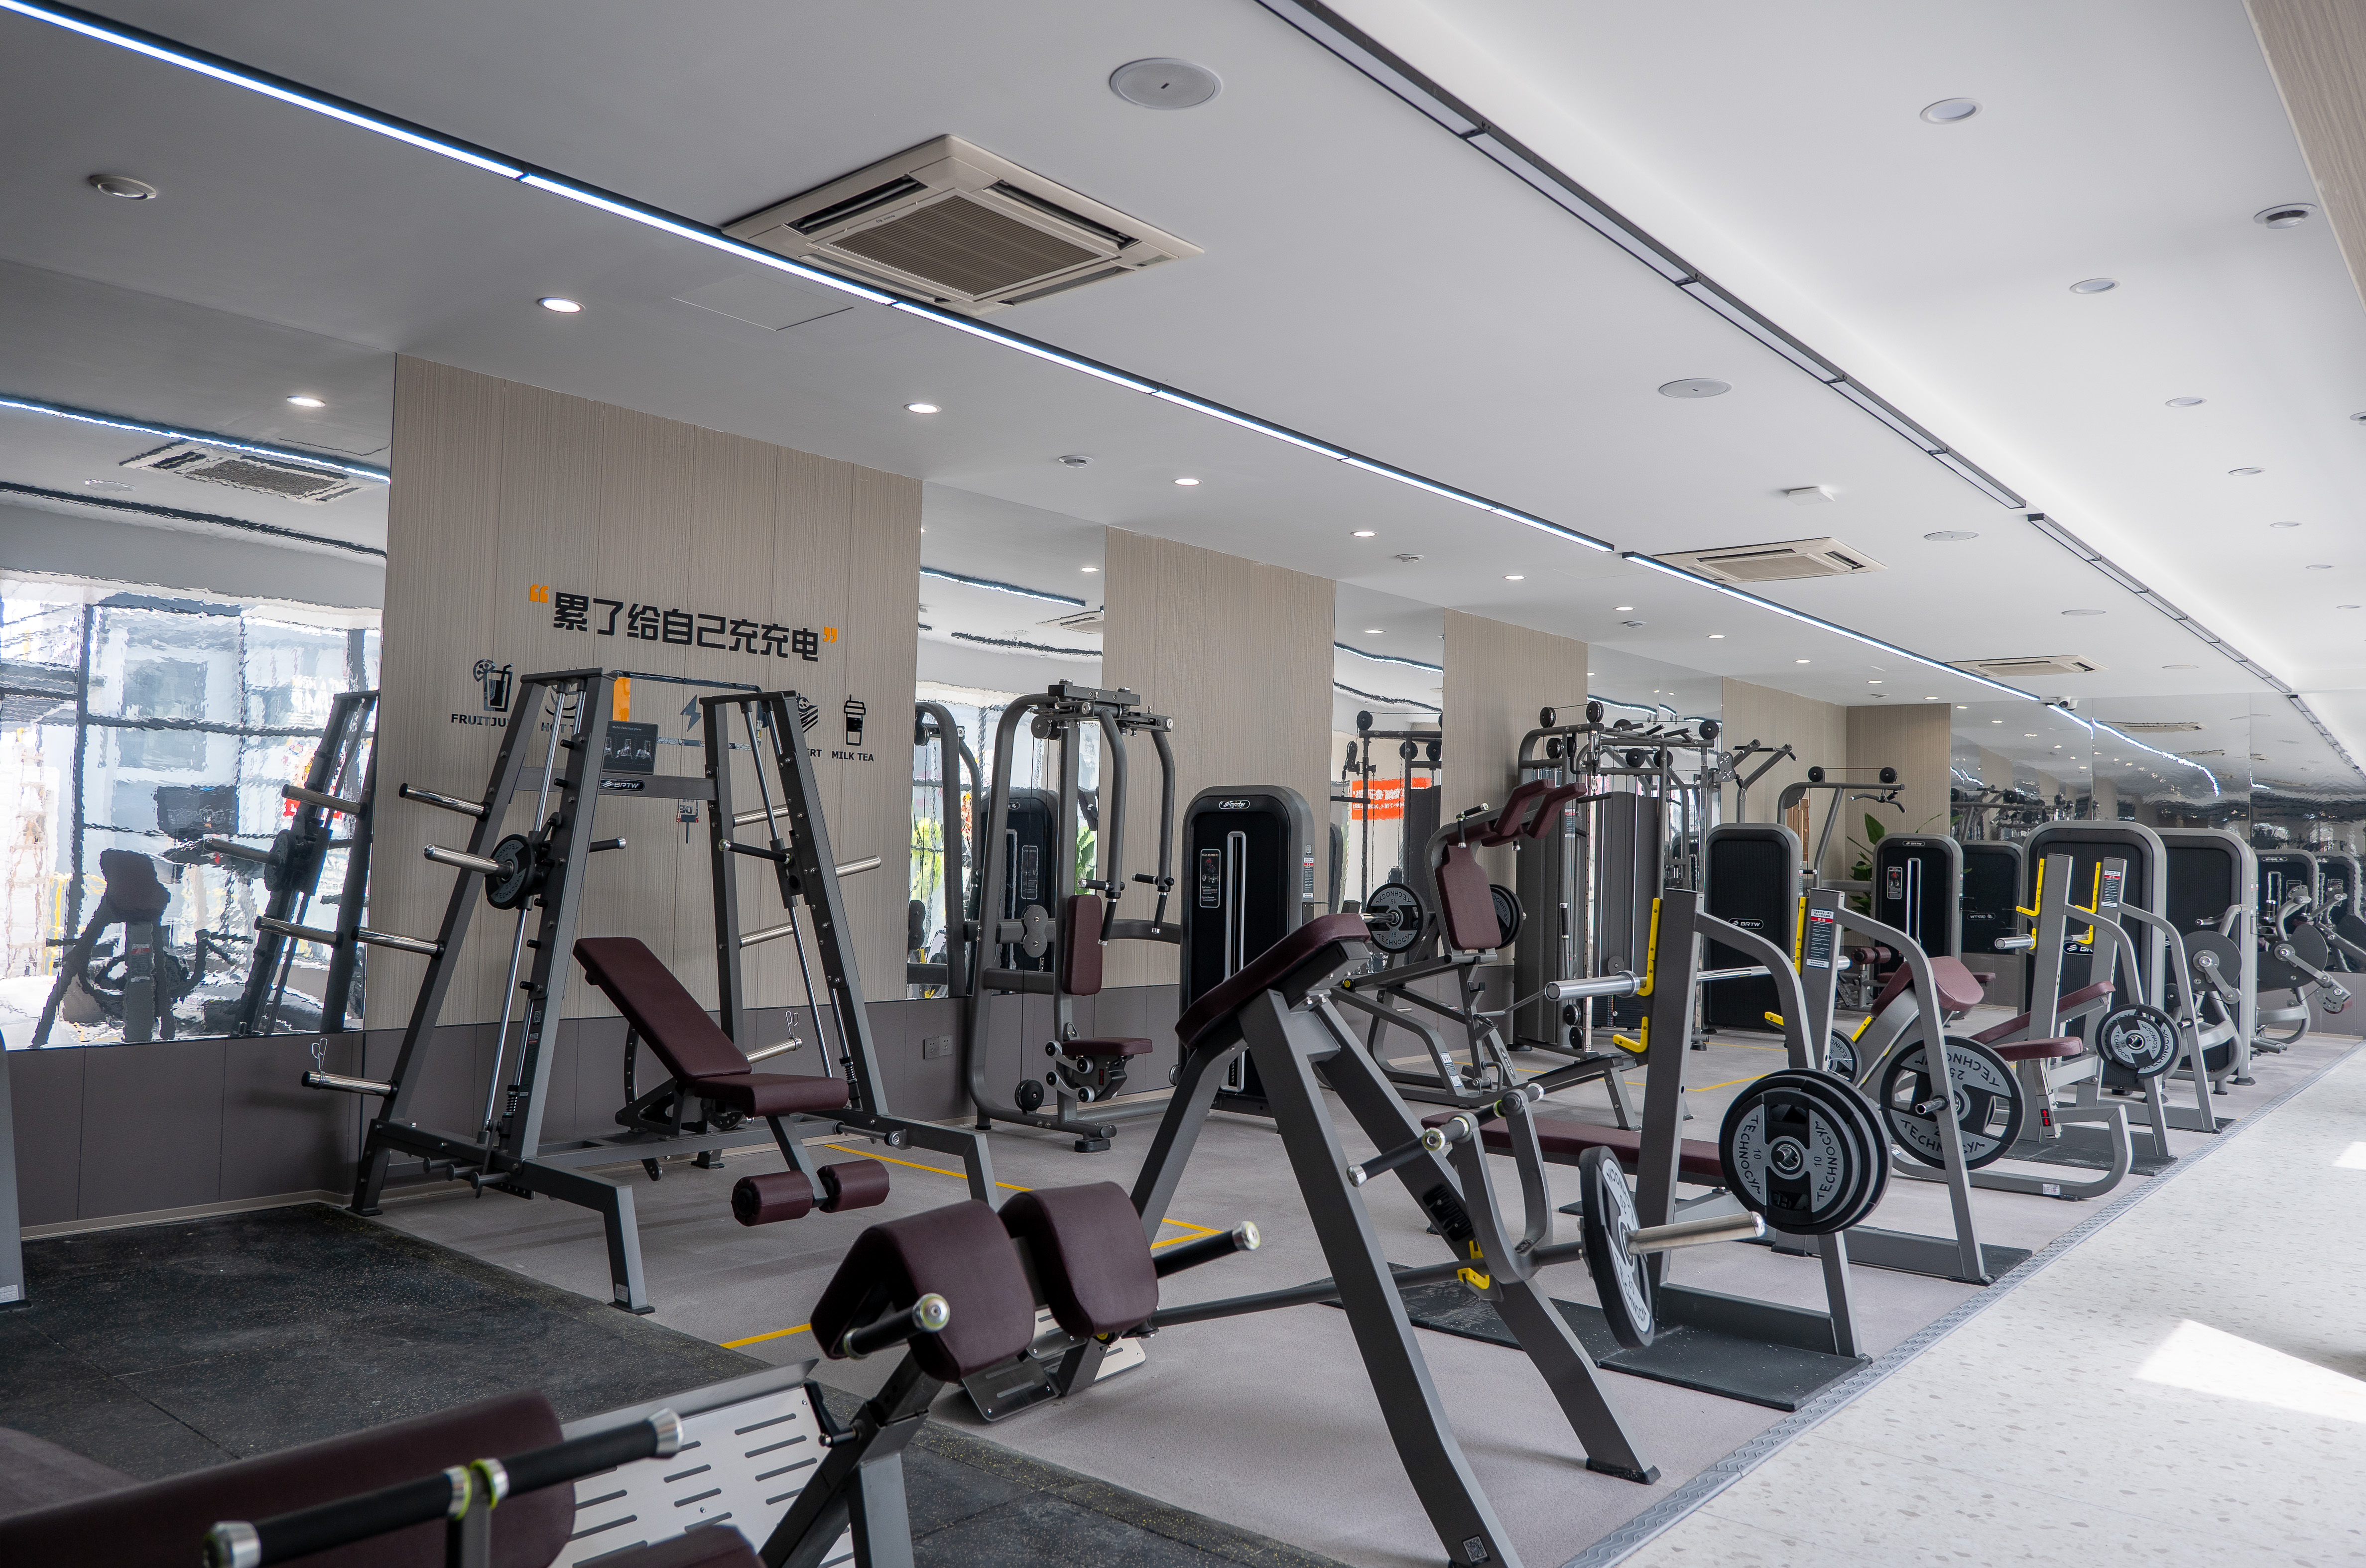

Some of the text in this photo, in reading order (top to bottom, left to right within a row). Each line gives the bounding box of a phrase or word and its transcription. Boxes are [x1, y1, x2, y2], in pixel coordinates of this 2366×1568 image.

[451, 713, 510, 727] FRUITJU
[831, 750, 874, 762] MILK TEA
[1376, 890, 1411, 903] TECHNOGYM
[1376, 933, 1412, 946] TECHNOGYM
[2113, 1030, 2130, 1060] TECHNOGYM
[2140, 1023, 2158, 1054] TECHNOGYM
[1949, 1068, 1965, 1081] 25
[1900, 1119, 1986, 1154] TECHNGYM
[1738, 1114, 1761, 1195] TECHNOGYM
[1753, 1148, 1761, 1160] 10
[1813, 1156, 1822, 1168] 10
[1814, 1120, 1838, 1202] TECHNOGYM
[1619, 1195, 1627, 1215] 20
[1627, 1275, 1635, 1295] 20
